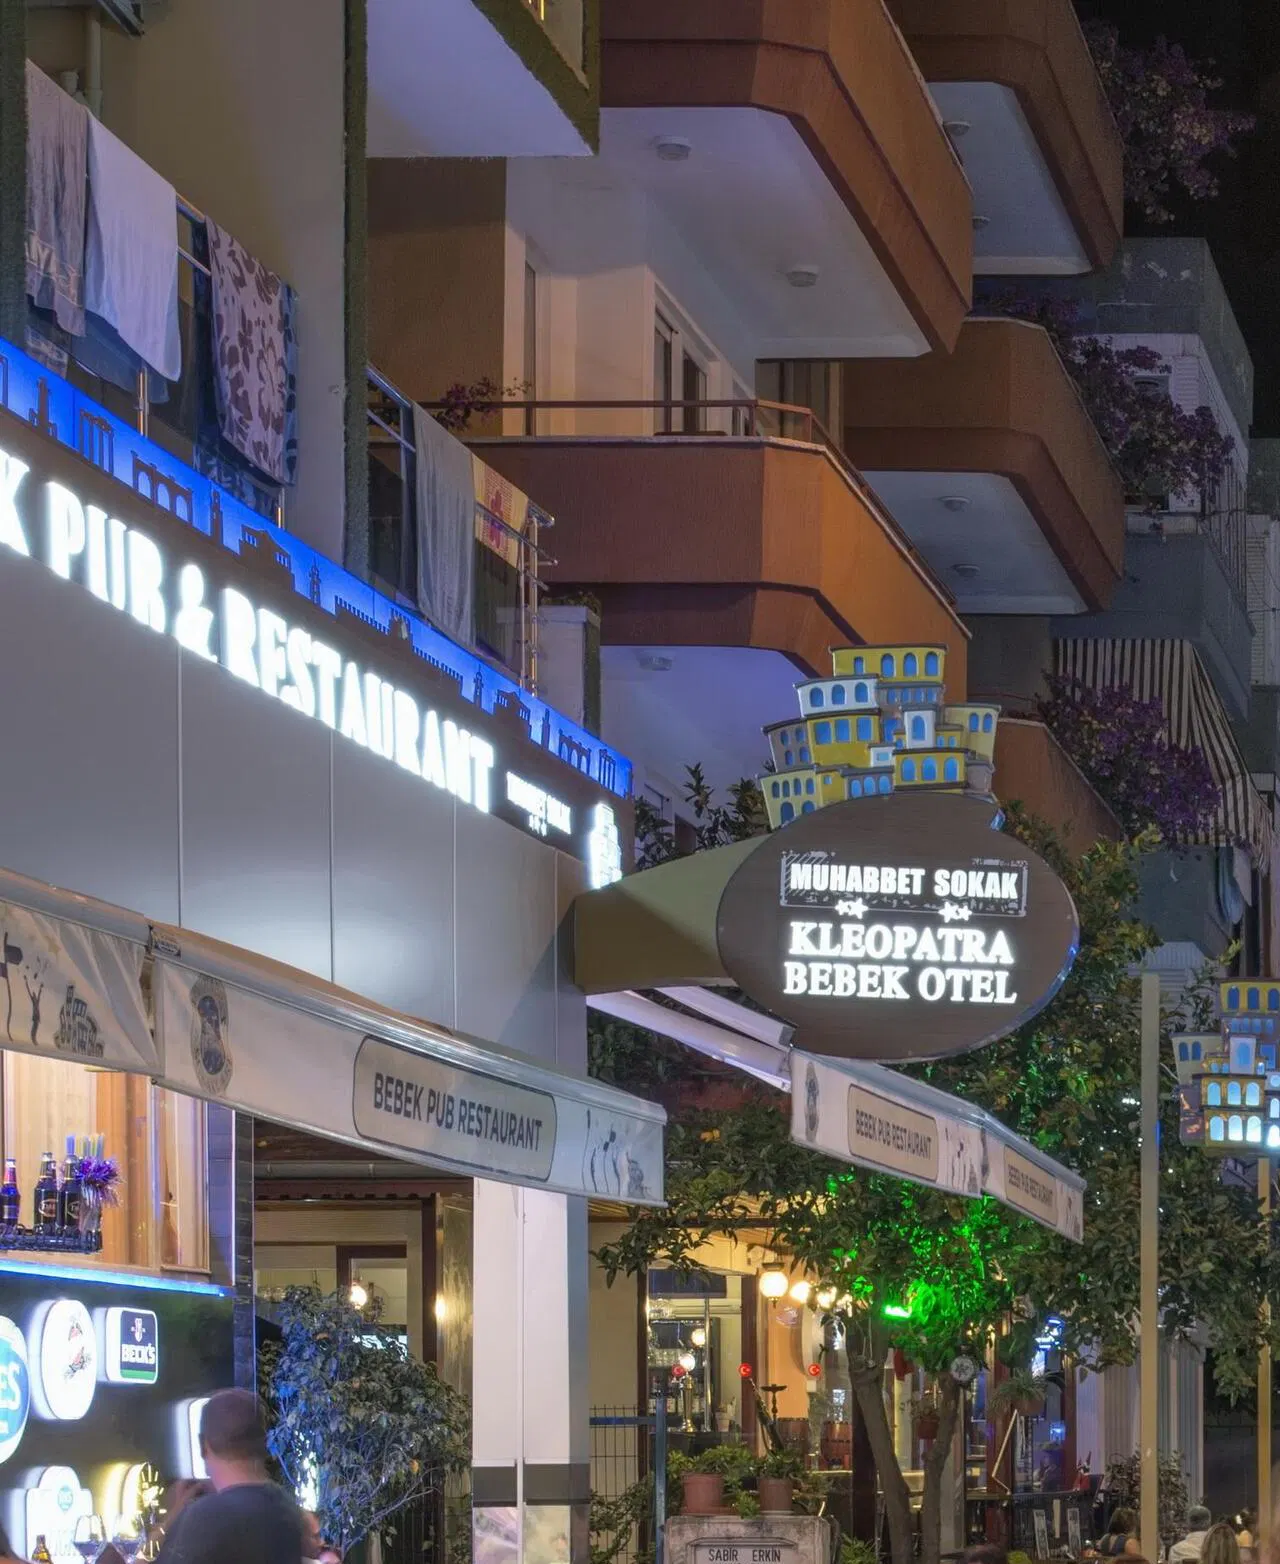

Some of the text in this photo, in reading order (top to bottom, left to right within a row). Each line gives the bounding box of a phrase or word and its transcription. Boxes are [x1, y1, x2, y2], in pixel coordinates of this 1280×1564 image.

[46, 480, 166, 634] PUB
[175, 564, 218, 663] &
[223, 587, 494, 814] RESTAURANT
[790, 863, 1018, 899] MUHABBET SOKAK
[789, 921, 1014, 964] KLEOPATRA
[783, 961, 1018, 1004] BEBEK OTEL
[374, 1072, 543, 1150] BEBEK PUB RESTAURANT
[856, 1109, 931, 1159] BEBEK PUB RESTAURANT
